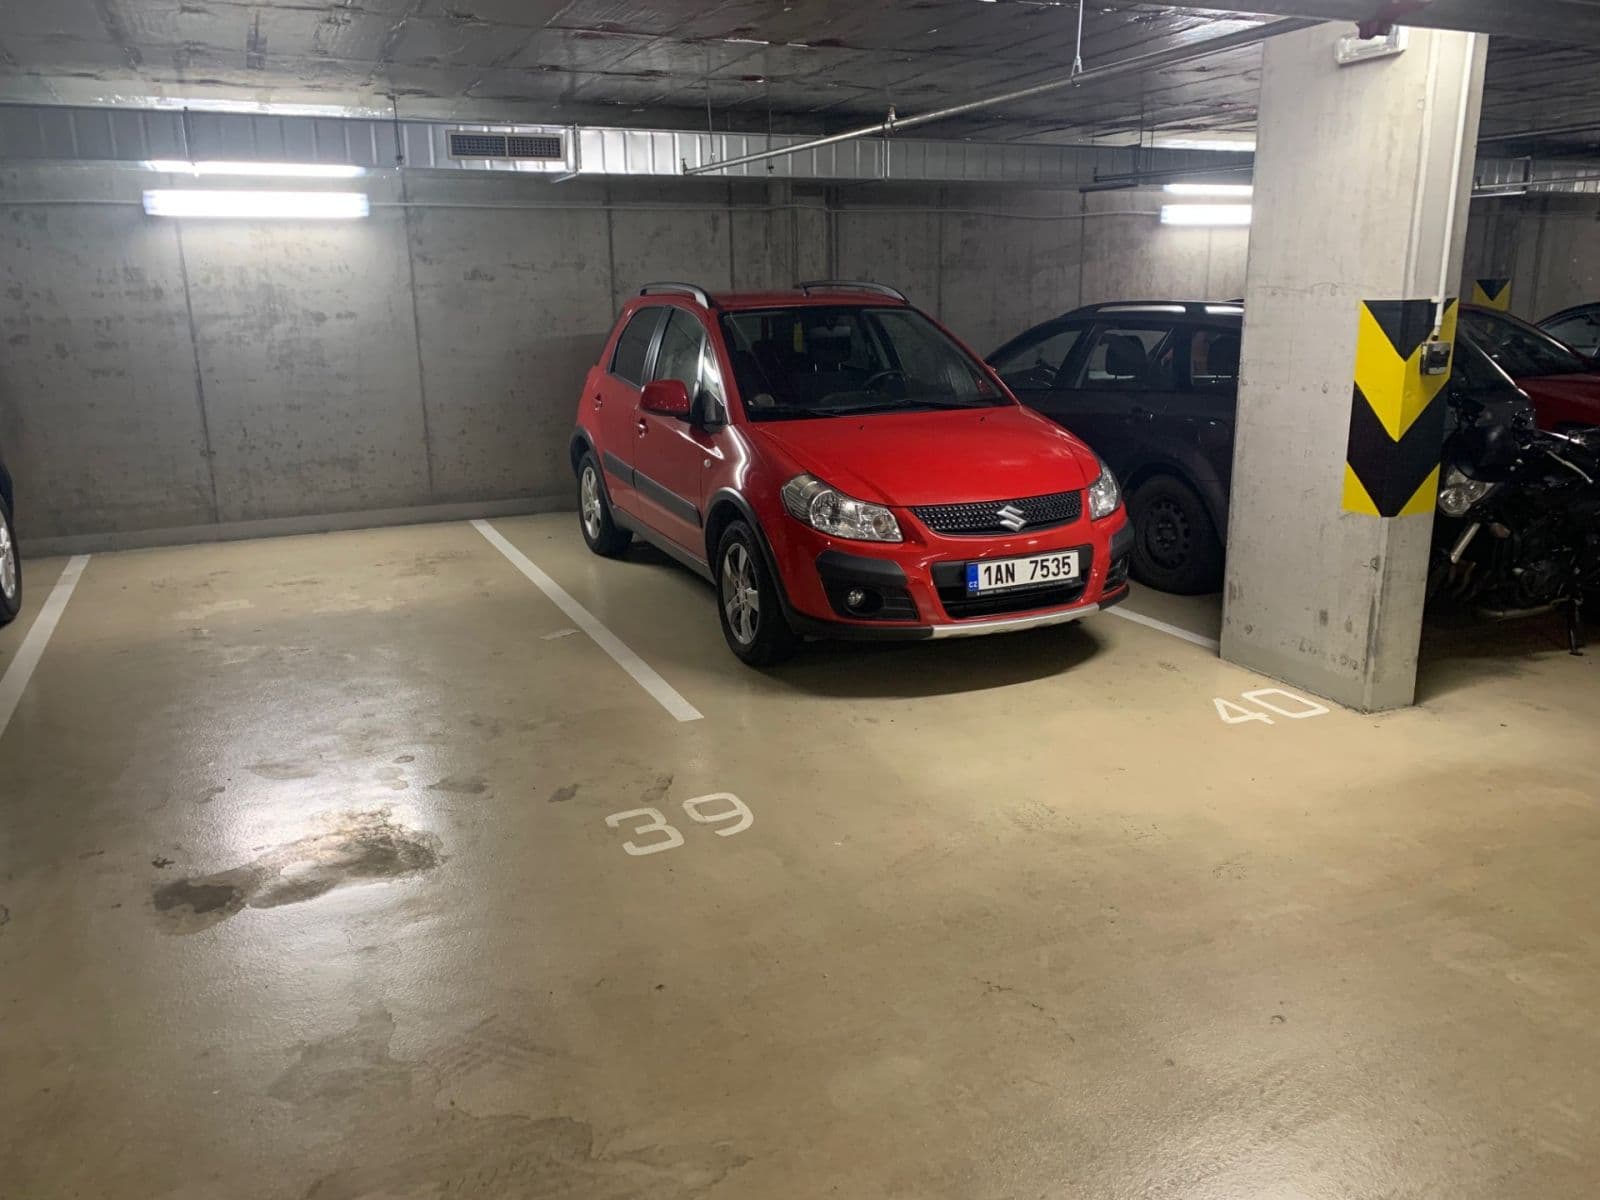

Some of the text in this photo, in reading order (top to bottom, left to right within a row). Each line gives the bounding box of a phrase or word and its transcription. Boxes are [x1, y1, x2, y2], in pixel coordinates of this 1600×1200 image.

[968, 580, 978, 588] CZ
[984, 555, 1071, 586] 1AN 7535
[1213, 688, 1330, 725] 40
[605, 792, 754, 856] 39
